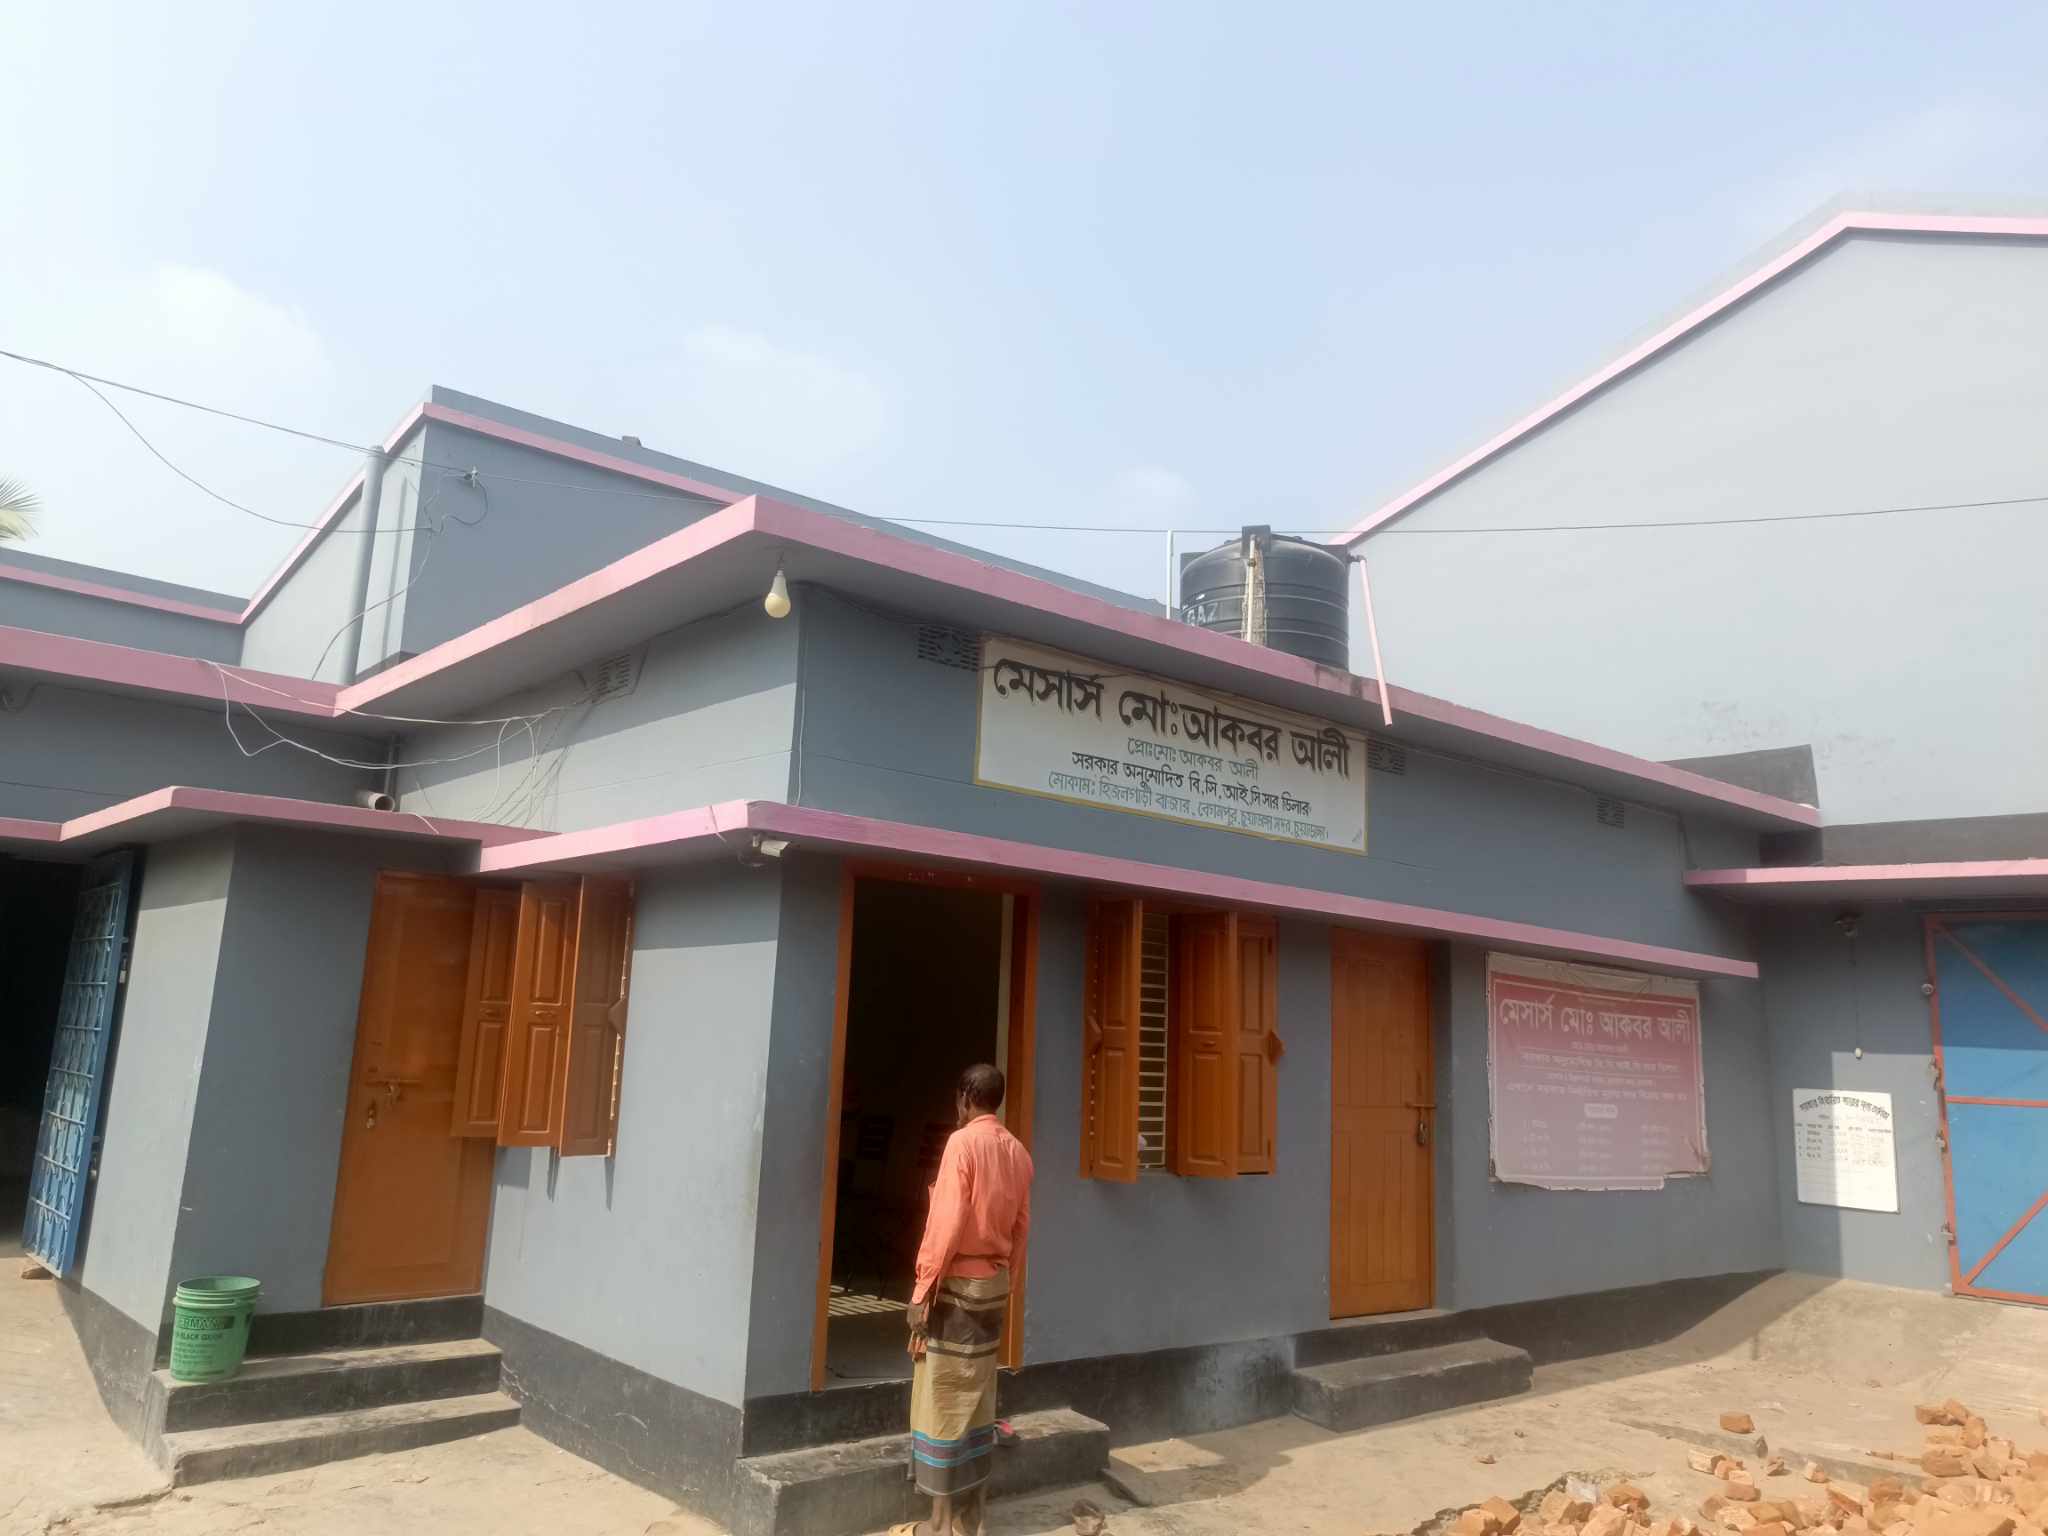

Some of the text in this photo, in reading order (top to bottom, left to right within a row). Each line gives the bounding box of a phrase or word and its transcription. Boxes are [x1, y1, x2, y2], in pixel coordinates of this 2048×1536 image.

[994, 658, 1105, 722] মেসার্স
[1290, 727, 1351, 779] আলী
[1072, 752, 1119, 775] সরকার
[1123, 764, 1184, 788] অনুমোদিত
[1281, 791, 1312, 816] ডিলার
[1179, 750, 1223, 772] আকবর
[1228, 759, 1260, 780] আলী
[1500, 994, 1556, 1031] মেসার্স
[1599, 1011, 1653, 1040] আকবর
[1657, 1009, 1691, 1043] আলী
